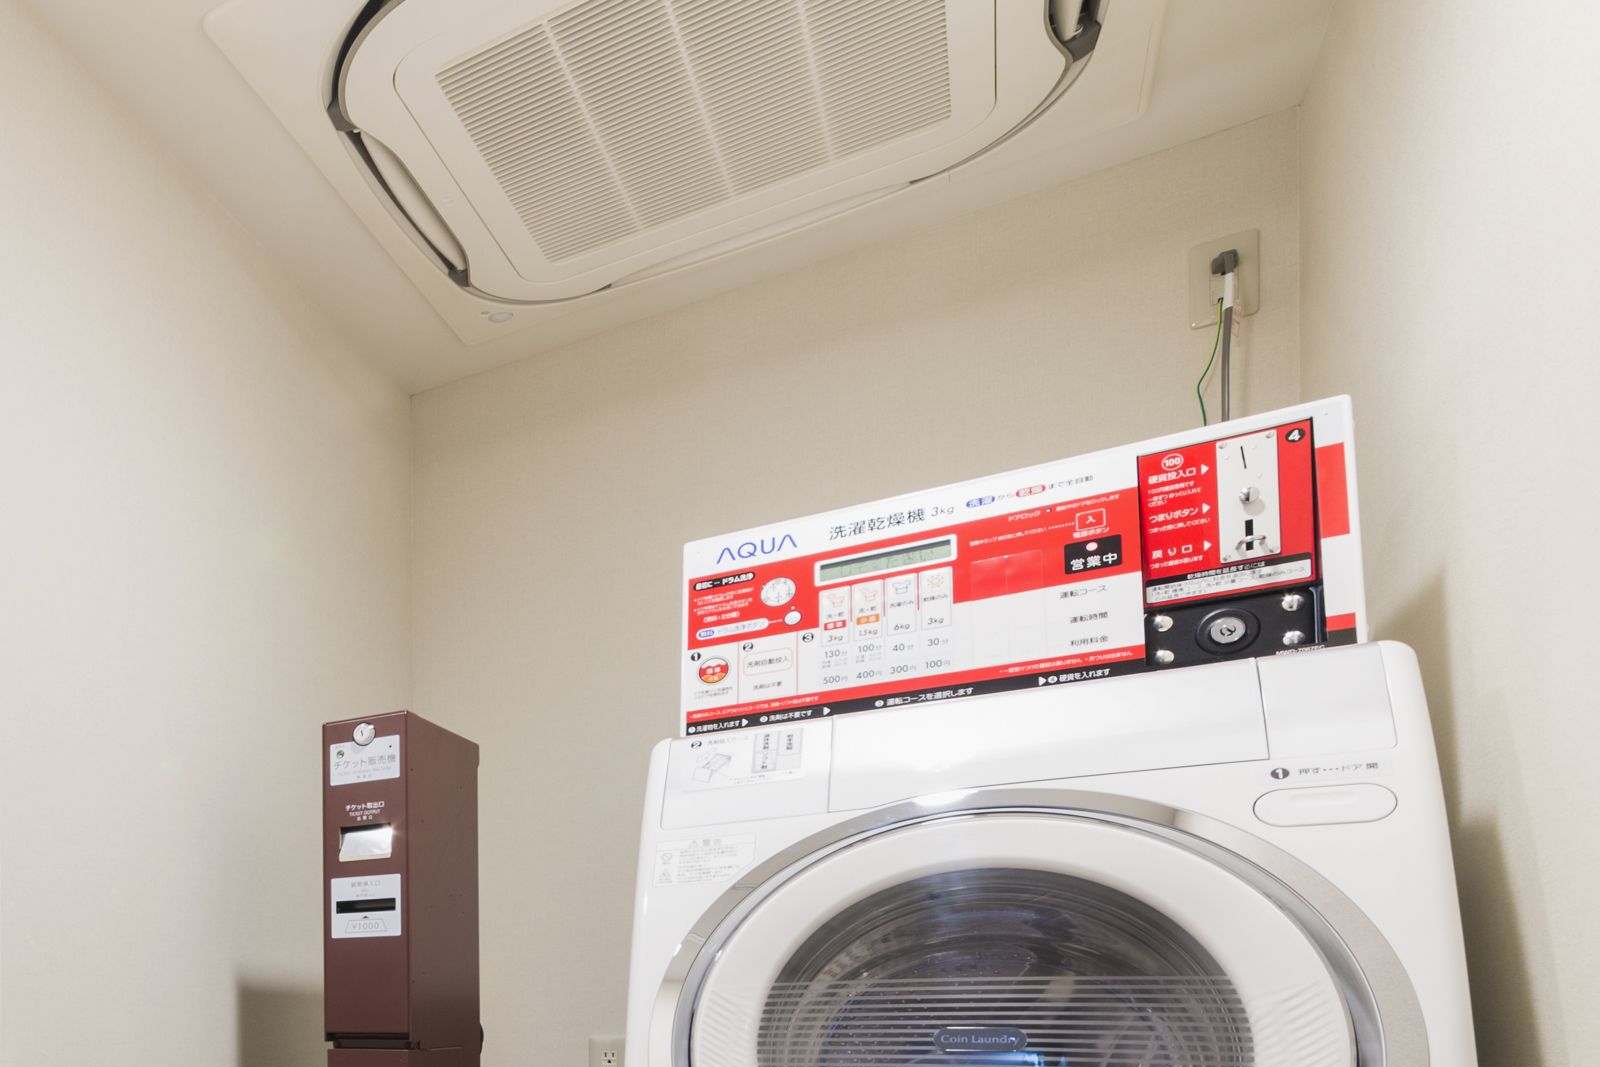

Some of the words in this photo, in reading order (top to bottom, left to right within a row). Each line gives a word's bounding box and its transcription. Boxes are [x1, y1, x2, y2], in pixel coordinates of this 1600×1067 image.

[1287, 427, 1303, 443] 4
[1164, 456, 1180, 467] 100
[1147, 466, 1195, 484] 硬貨投入口
[829, 507, 925, 540] 洗濯乾燥機
[931, 502, 954, 517] 3kg
[1148, 506, 1198, 523] つまりボタン
[716, 532, 797, 564] AQUA
[1070, 551, 1117, 570] 営業中
[1059, 667, 1110, 682] 硬貨を入れます
[940, 1034, 968, 1044] Coin
[971, 1034, 1019, 1046] Laundry
